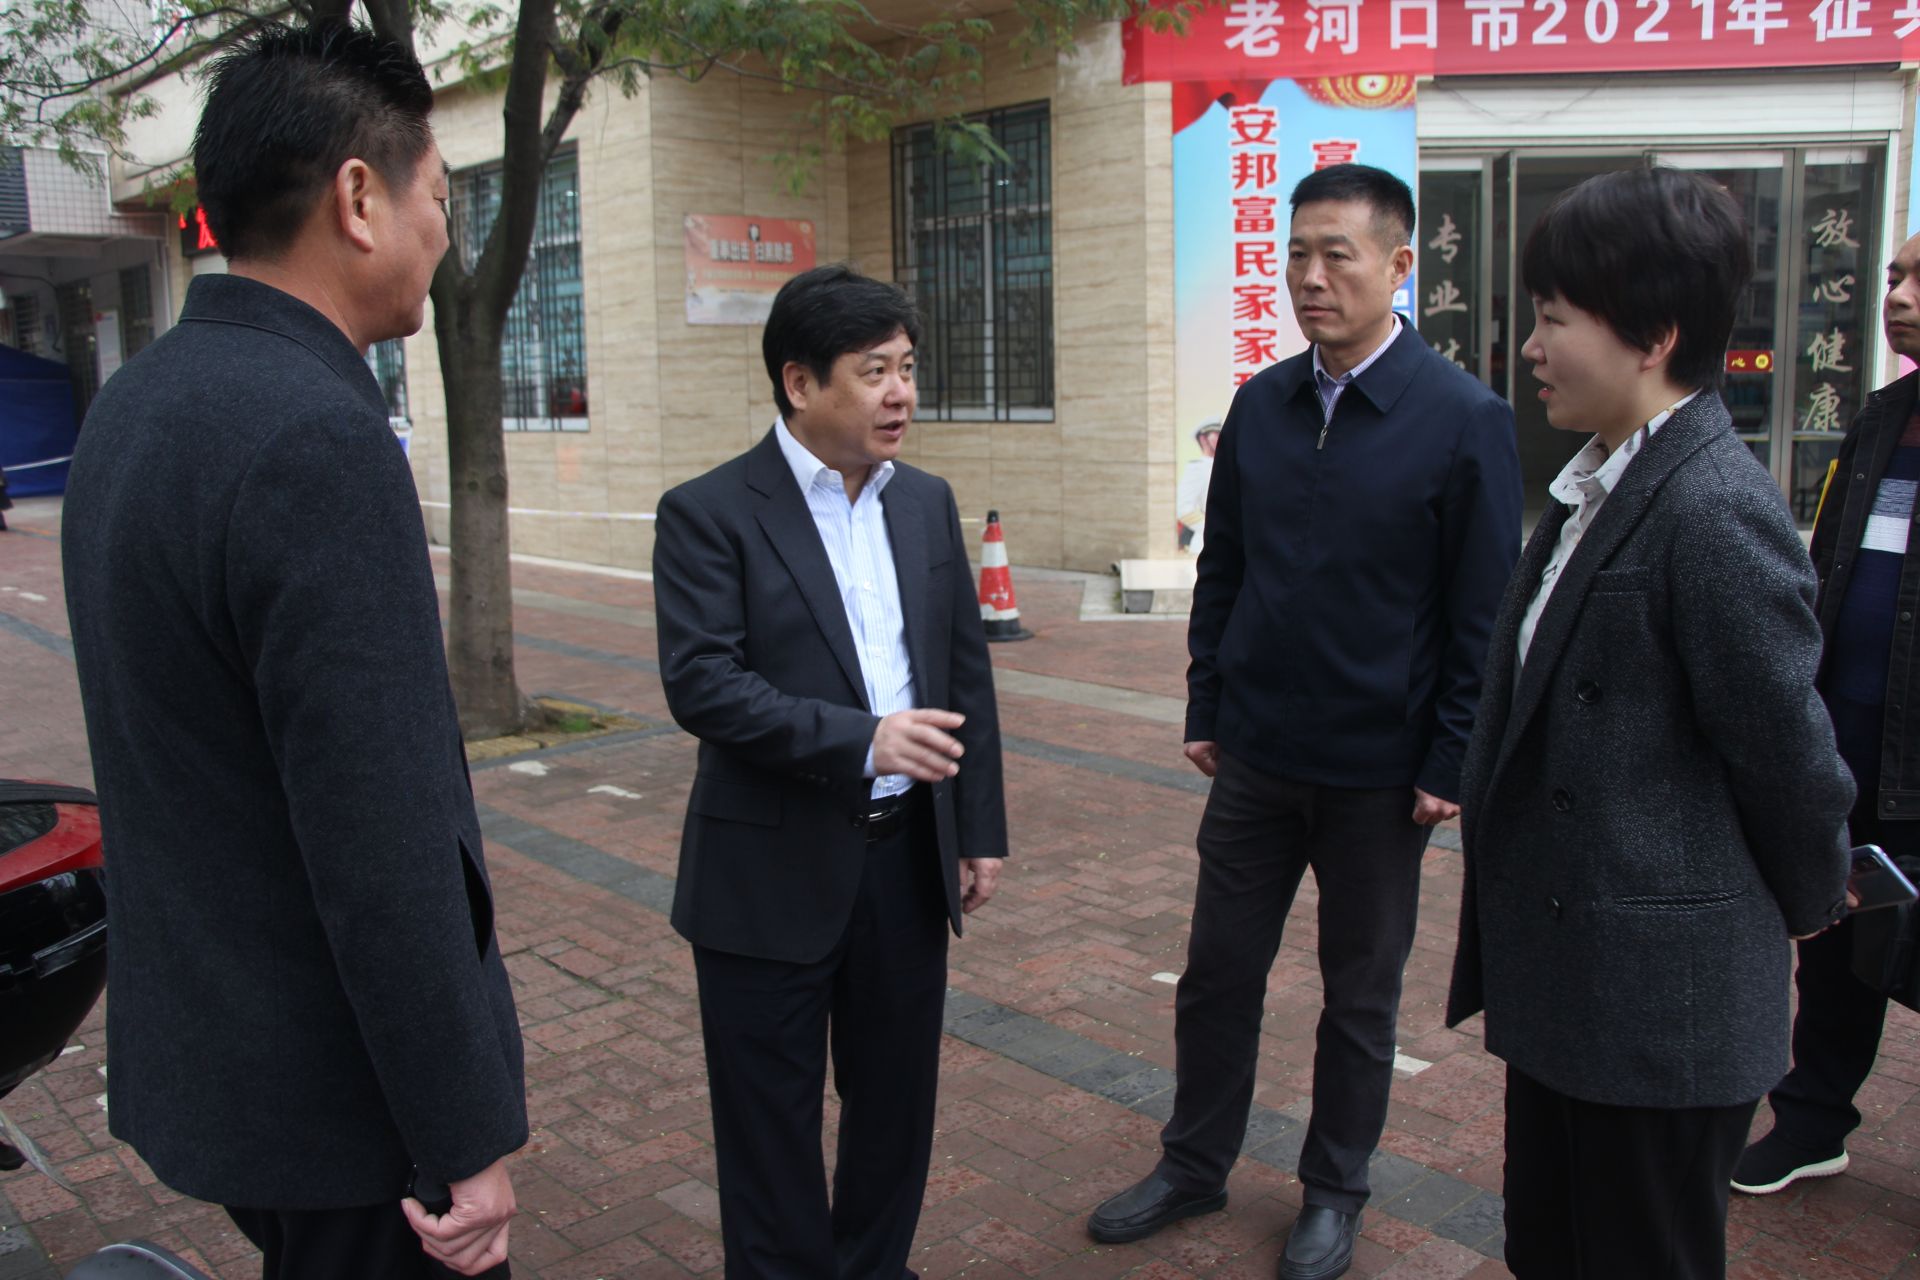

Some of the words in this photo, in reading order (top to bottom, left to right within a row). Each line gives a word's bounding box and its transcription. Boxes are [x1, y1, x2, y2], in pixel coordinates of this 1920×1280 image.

[1231, 108, 1278, 387] 安邦富民家家
[1802, 209, 1860, 432] 放心健康
